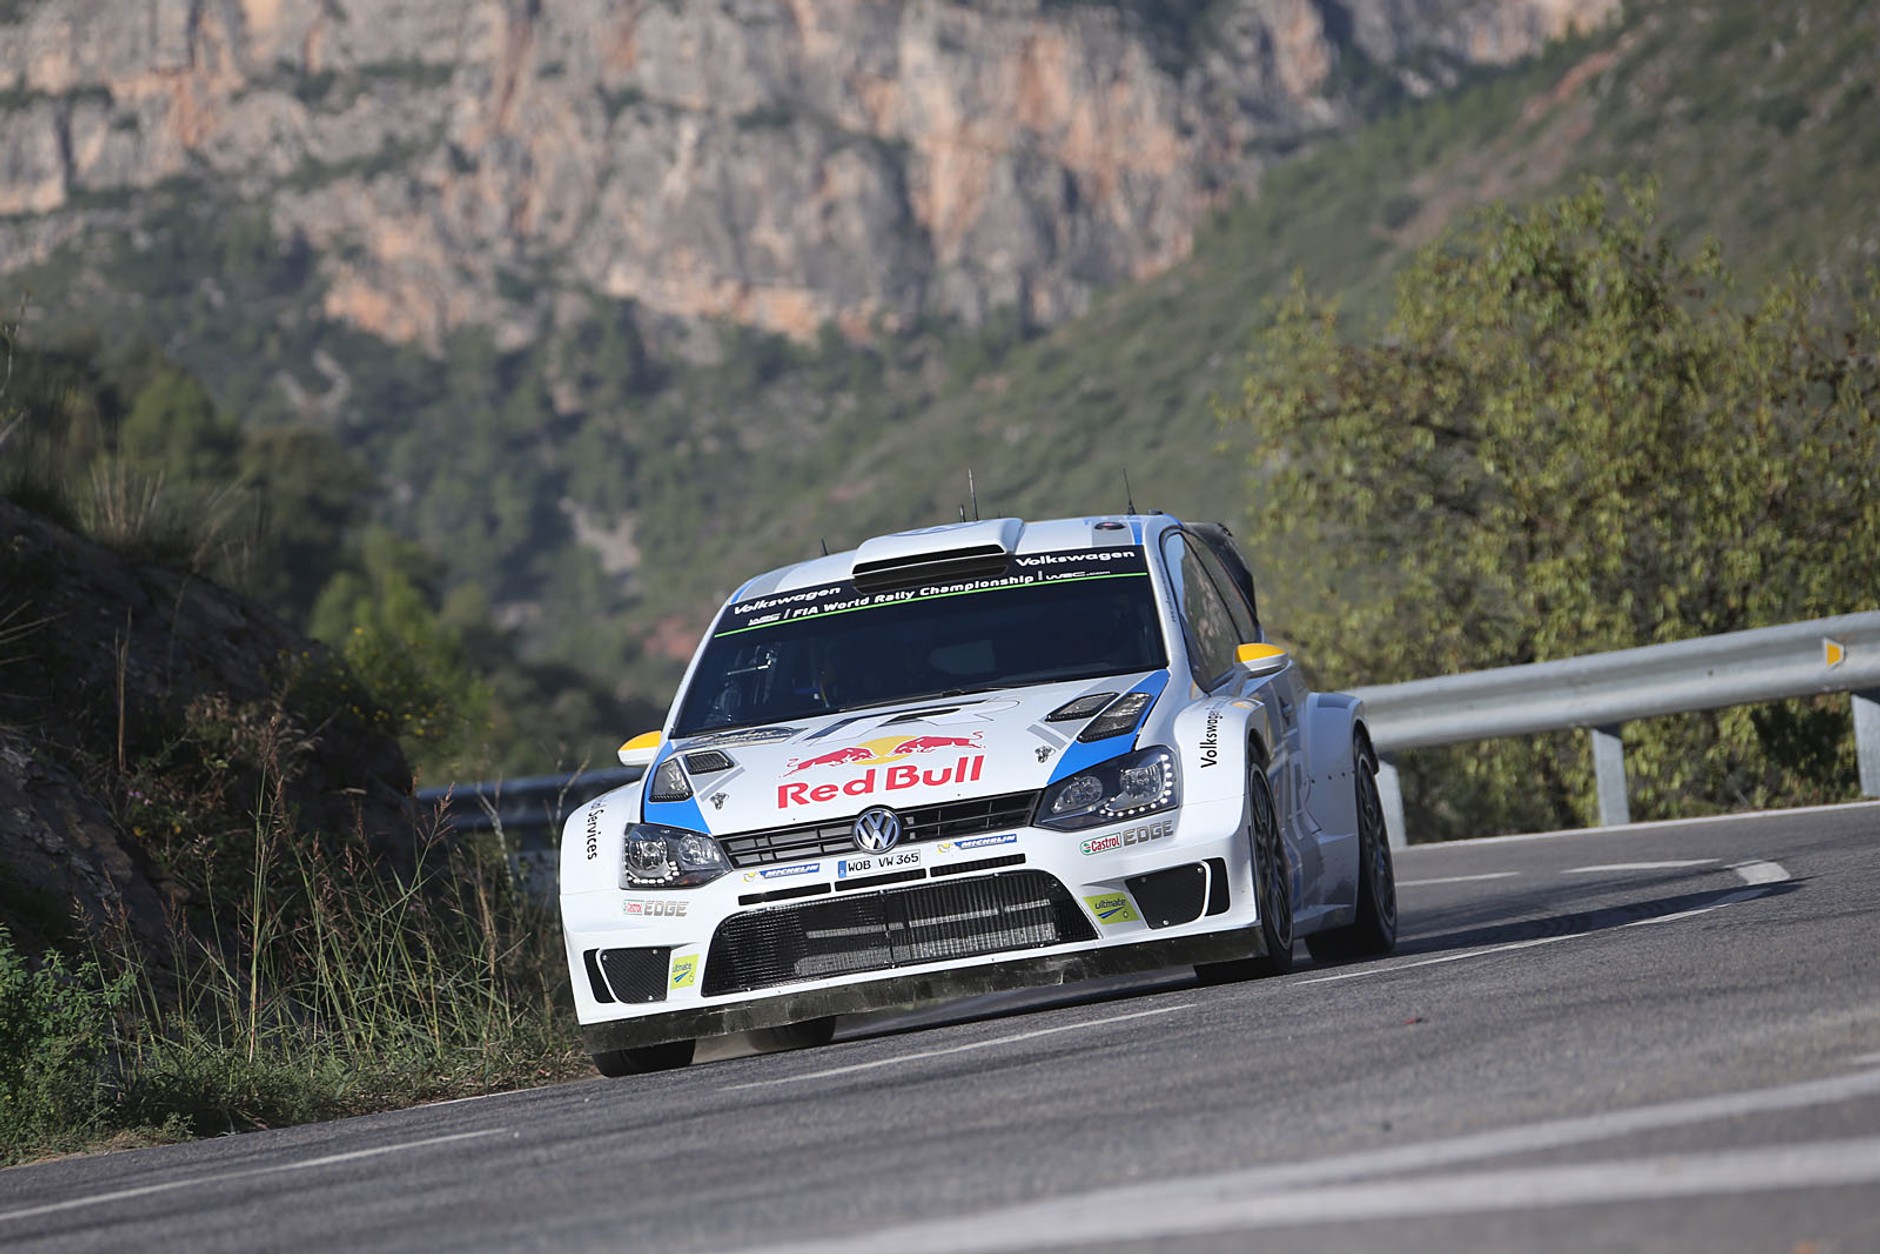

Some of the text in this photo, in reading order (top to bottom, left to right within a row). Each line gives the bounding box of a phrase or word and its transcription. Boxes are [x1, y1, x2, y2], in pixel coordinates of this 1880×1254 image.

[1015, 551, 1135, 567] Volkswagen
[734, 587, 841, 615] Volkswagen
[792, 606, 818, 618] FIA
[823, 596, 870, 612] World
[874, 590, 915, 604] Rally
[919, 575, 1034, 596] Championship
[778, 755, 985, 809] Red Bull
[586, 808, 605, 861] Services
[961, 836, 1016, 848] MICHELIN
[1091, 820, 1174, 852] Castrol EDGE
[765, 865, 819, 878] MICHELIN
[847, 860, 872, 872] WOB
[878, 856, 894, 868] VW
[896, 852, 919, 865] 365
[643, 900, 690, 917] EDGE
[1095, 898, 1126, 910] ultimate
